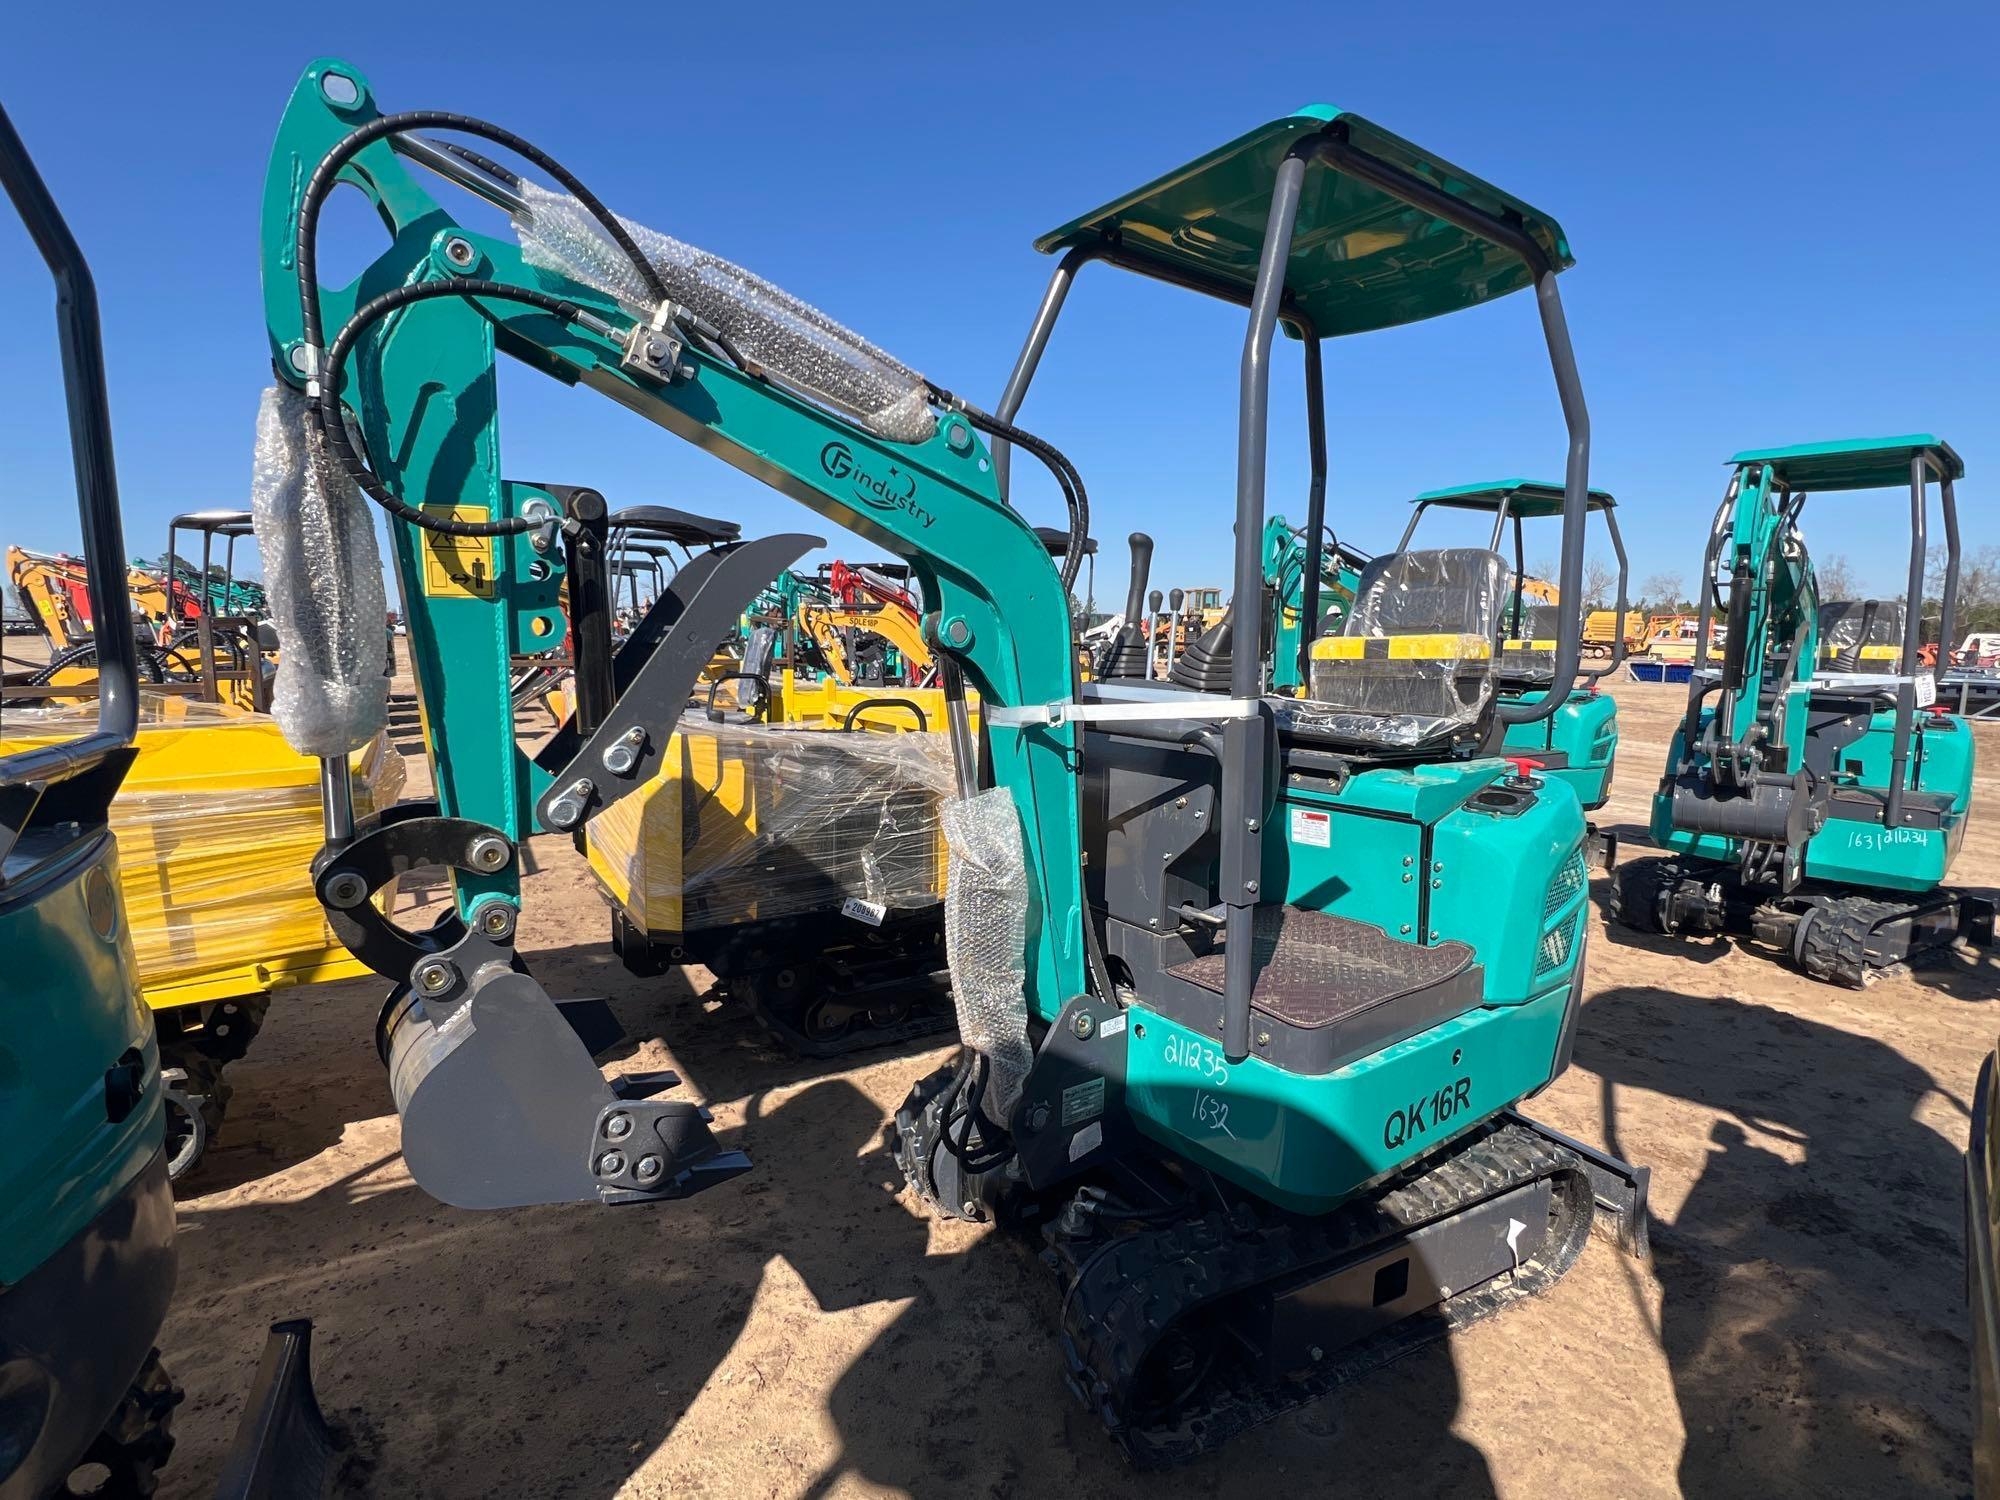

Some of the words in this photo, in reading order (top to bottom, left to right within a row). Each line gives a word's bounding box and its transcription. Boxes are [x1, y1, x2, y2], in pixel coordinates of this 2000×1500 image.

[1883, 829, 1929, 847] 211234
[1164, 1034, 1229, 1086] 211235
[1192, 1088, 1237, 1141] 1632
